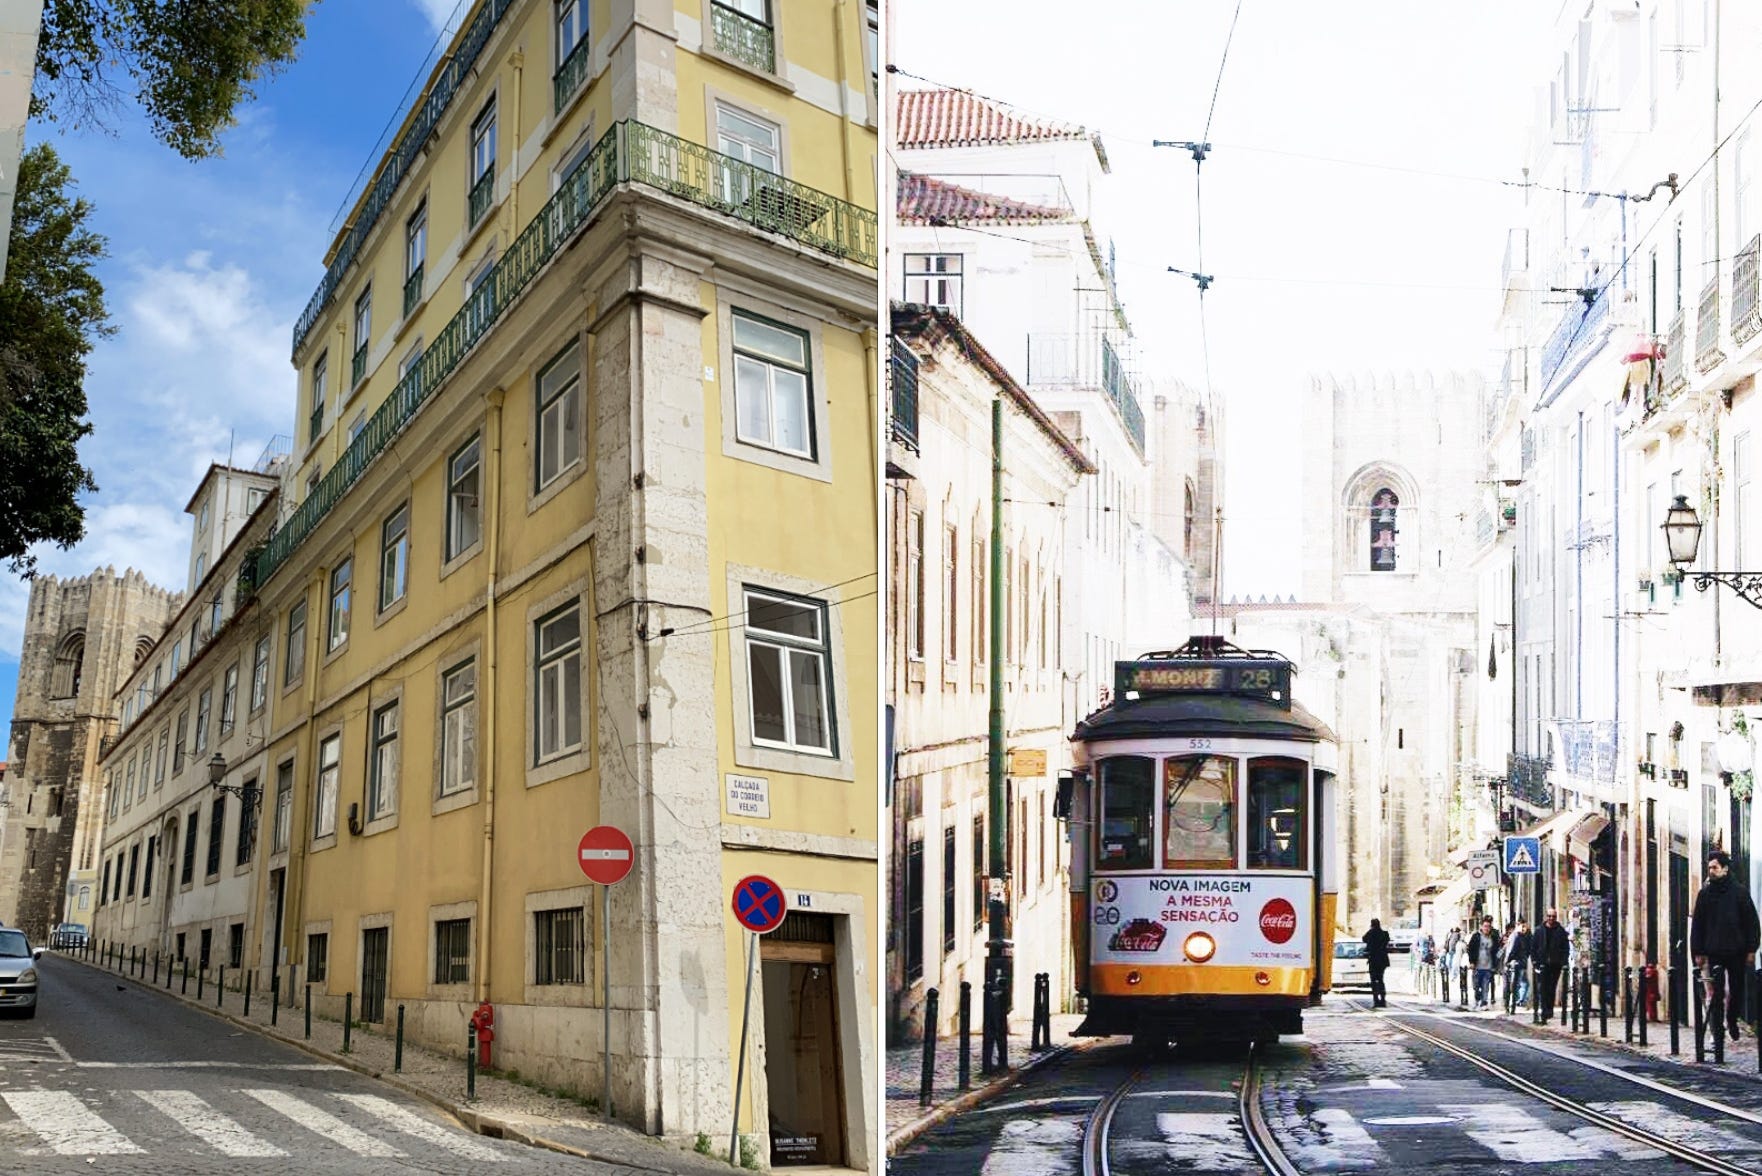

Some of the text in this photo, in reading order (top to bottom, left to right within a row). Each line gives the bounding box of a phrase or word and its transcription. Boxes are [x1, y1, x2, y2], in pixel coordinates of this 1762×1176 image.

[1240, 669, 1272, 688] 28
[1189, 739, 1211, 749] 552
[734, 780, 760, 790] CALÇADA
[731, 790, 764, 802] DO CORREIO
[739, 802, 758, 812] VELHO
[1149, 879, 1251, 893] NOVA IMAGEM
[1166, 895, 1233, 907] A MESMA
[1161, 908, 1239, 924] SENSAÇÃO
